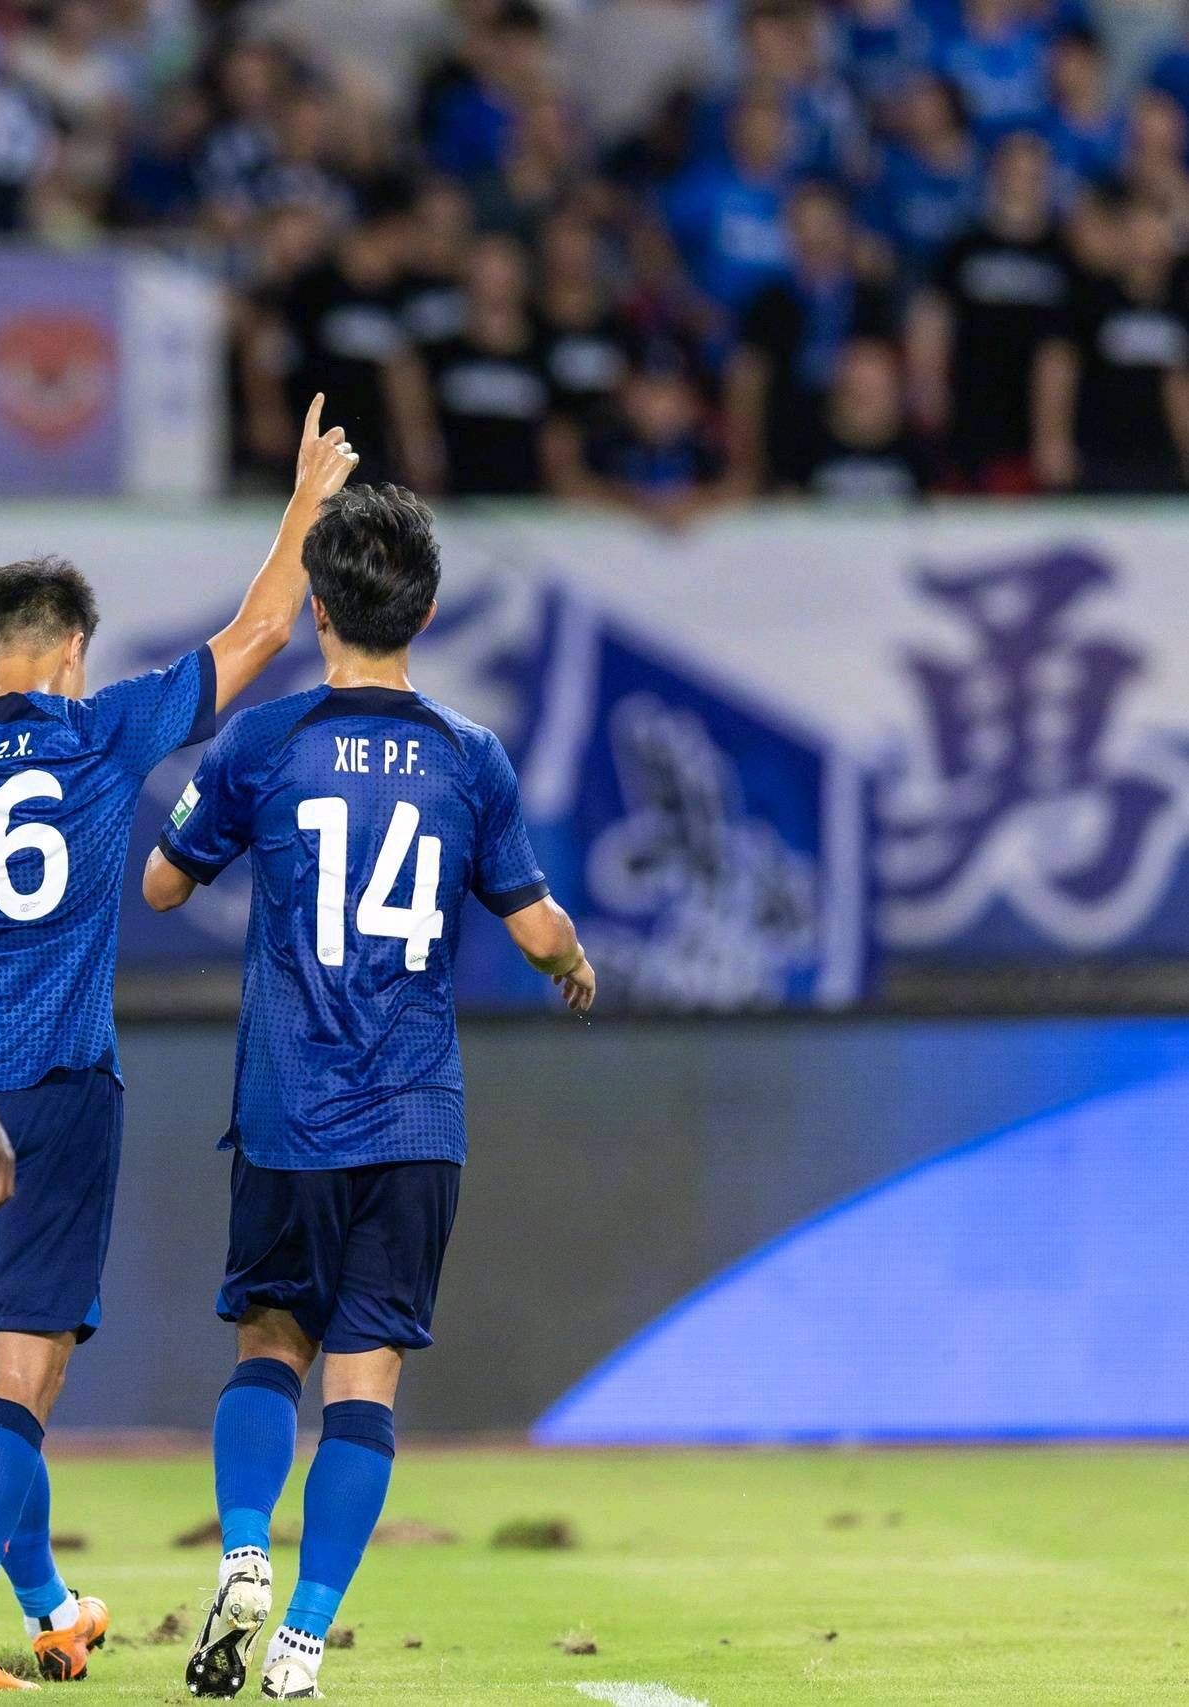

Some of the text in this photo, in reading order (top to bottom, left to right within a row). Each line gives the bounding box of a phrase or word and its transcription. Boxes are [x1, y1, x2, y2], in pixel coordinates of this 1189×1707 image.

[334, 736, 425, 776] XIE P.F.
[297, 796, 444, 972] 14
